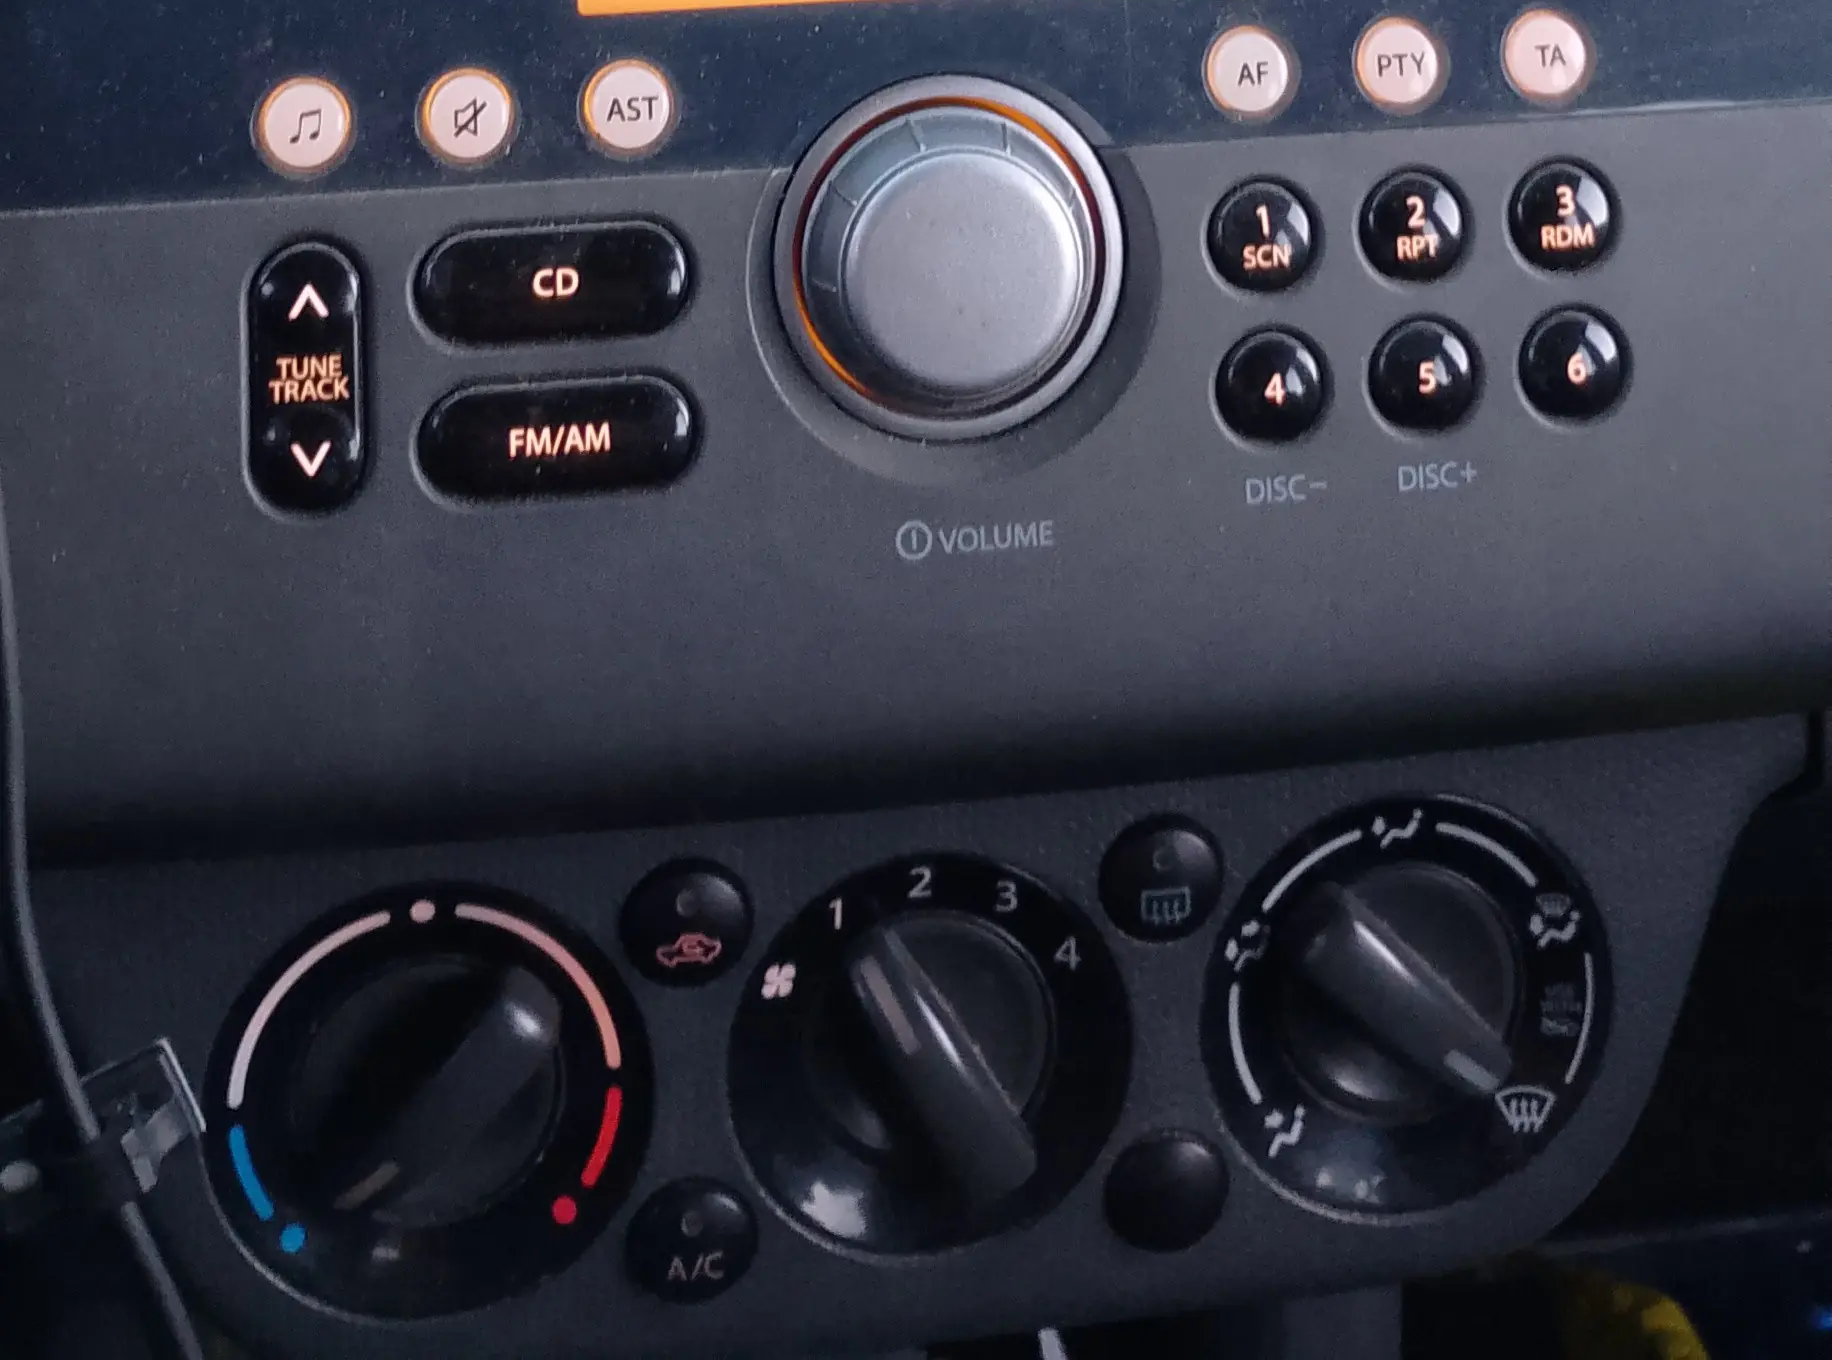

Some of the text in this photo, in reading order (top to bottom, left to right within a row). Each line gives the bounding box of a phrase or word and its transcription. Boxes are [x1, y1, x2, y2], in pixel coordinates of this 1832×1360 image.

[1377, 51, 1426, 79] PTY
[1535, 43, 1568, 68] TA
[1237, 61, 1270, 87] AF
[606, 96, 659, 124] AST
[1404, 194, 1427, 231] 2
[1555, 183, 1576, 218] 3
[1255, 203, 1271, 238] 1
[1395, 232, 1441, 262] RPT
[1539, 223, 1596, 252] RDM
[1241, 242, 1292, 271] SCN
[532, 266, 580, 299] CD
[275, 353, 343, 381] TUNE
[1417, 360, 1438, 396] 5
[1566, 350, 1587, 386] 6
[267, 377, 350, 405] TRACK
[1263, 370, 1287, 407] 4
[508, 421, 612, 460] FM/AM
[1398, 463, 1478, 493] DISC+
[937, 519, 1055, 555] VOLUME
[828, 865, 1082, 971] 1 2 3 4
[666, 1250, 726, 1282] A/C
